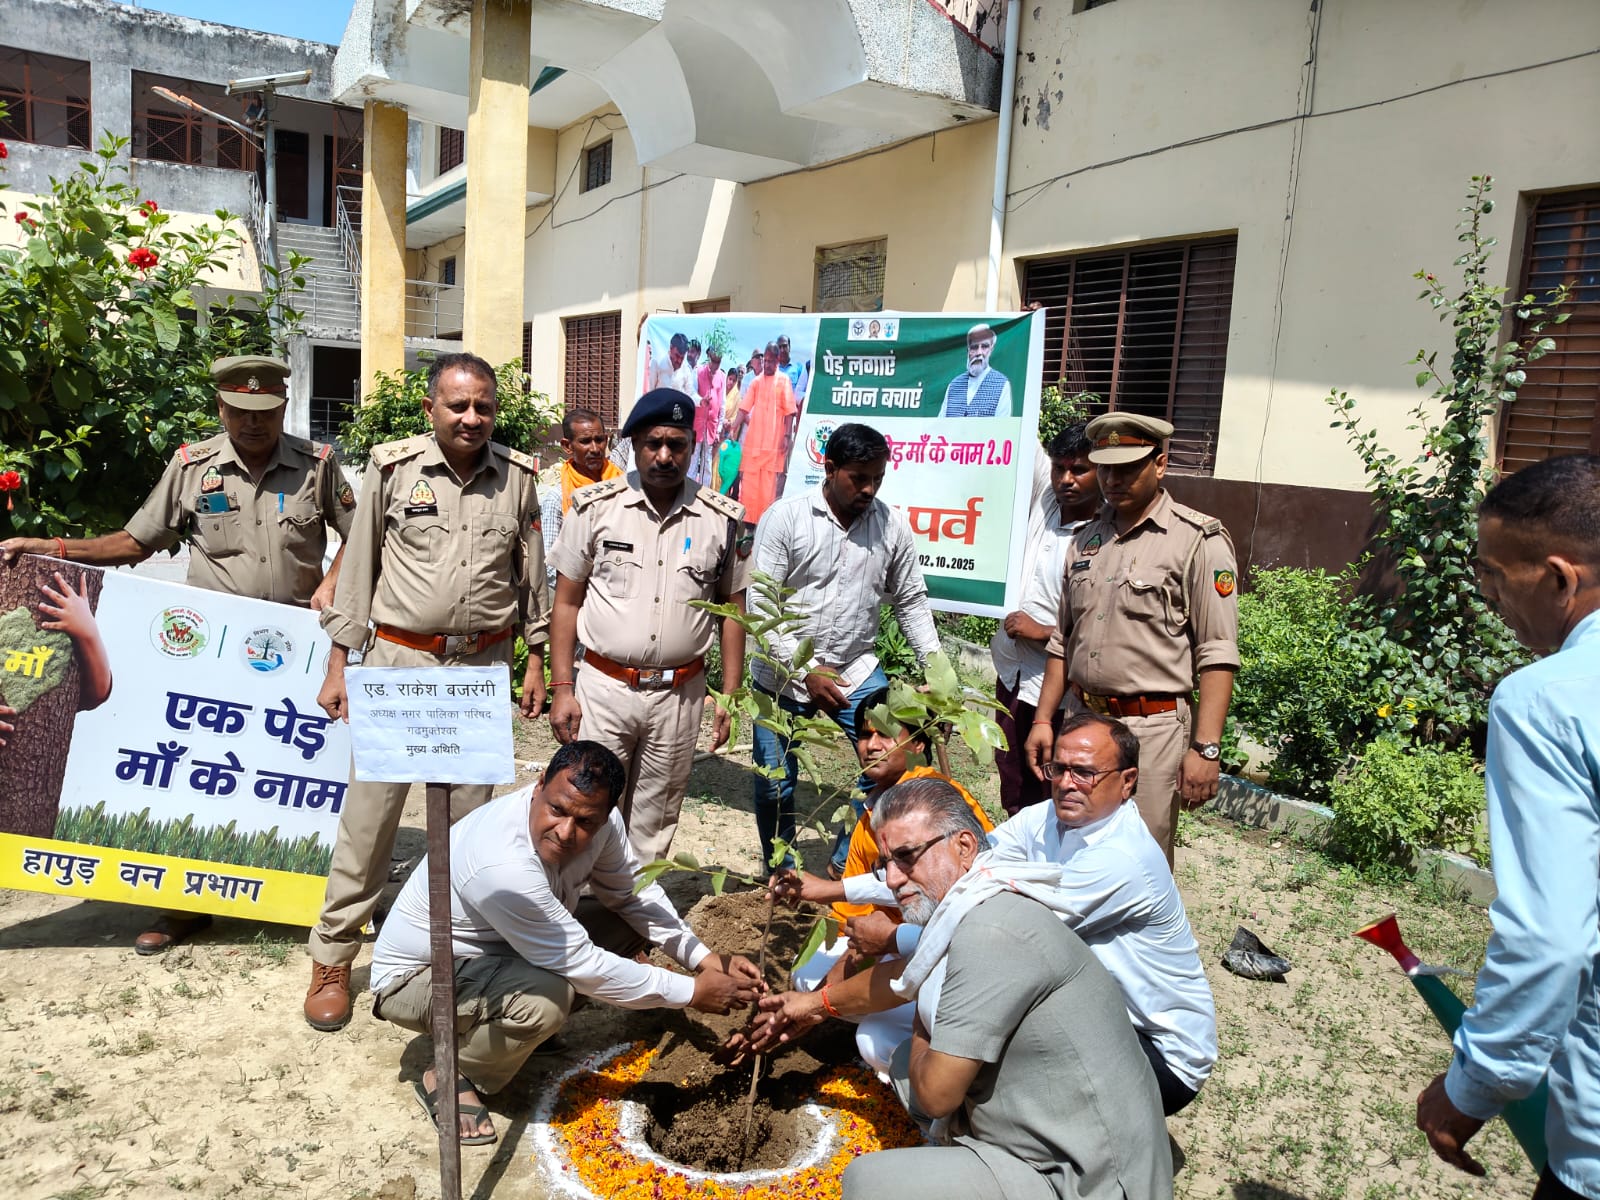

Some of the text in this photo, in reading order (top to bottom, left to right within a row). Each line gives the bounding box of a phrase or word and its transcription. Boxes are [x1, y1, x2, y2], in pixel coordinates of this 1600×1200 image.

[822, 349, 896, 381] पेड़ लगाएं
[831, 381, 923, 409] जीवन बचाएं
[906, 433, 931, 464] माँ
[929, 436, 948, 464] के
[950, 442, 985, 465] नाम
[986, 439, 1012, 465] 2.0
[907, 497, 984, 545] पर्व
[919, 554, 975, 571] 02.10.2025
[4, 645, 55, 678] माँ
[363, 679, 496, 698] एड. राकेश बजरंगी
[165, 691, 334, 760] एक पेड़
[370, 707, 492, 719] अध्यक्ष नगर पालिका परिषद
[406, 744, 426, 757] मुख्य
[115, 740, 348, 814] माँ के नाम
[23, 849, 263, 902] हापुड़ वन प्रभाग
